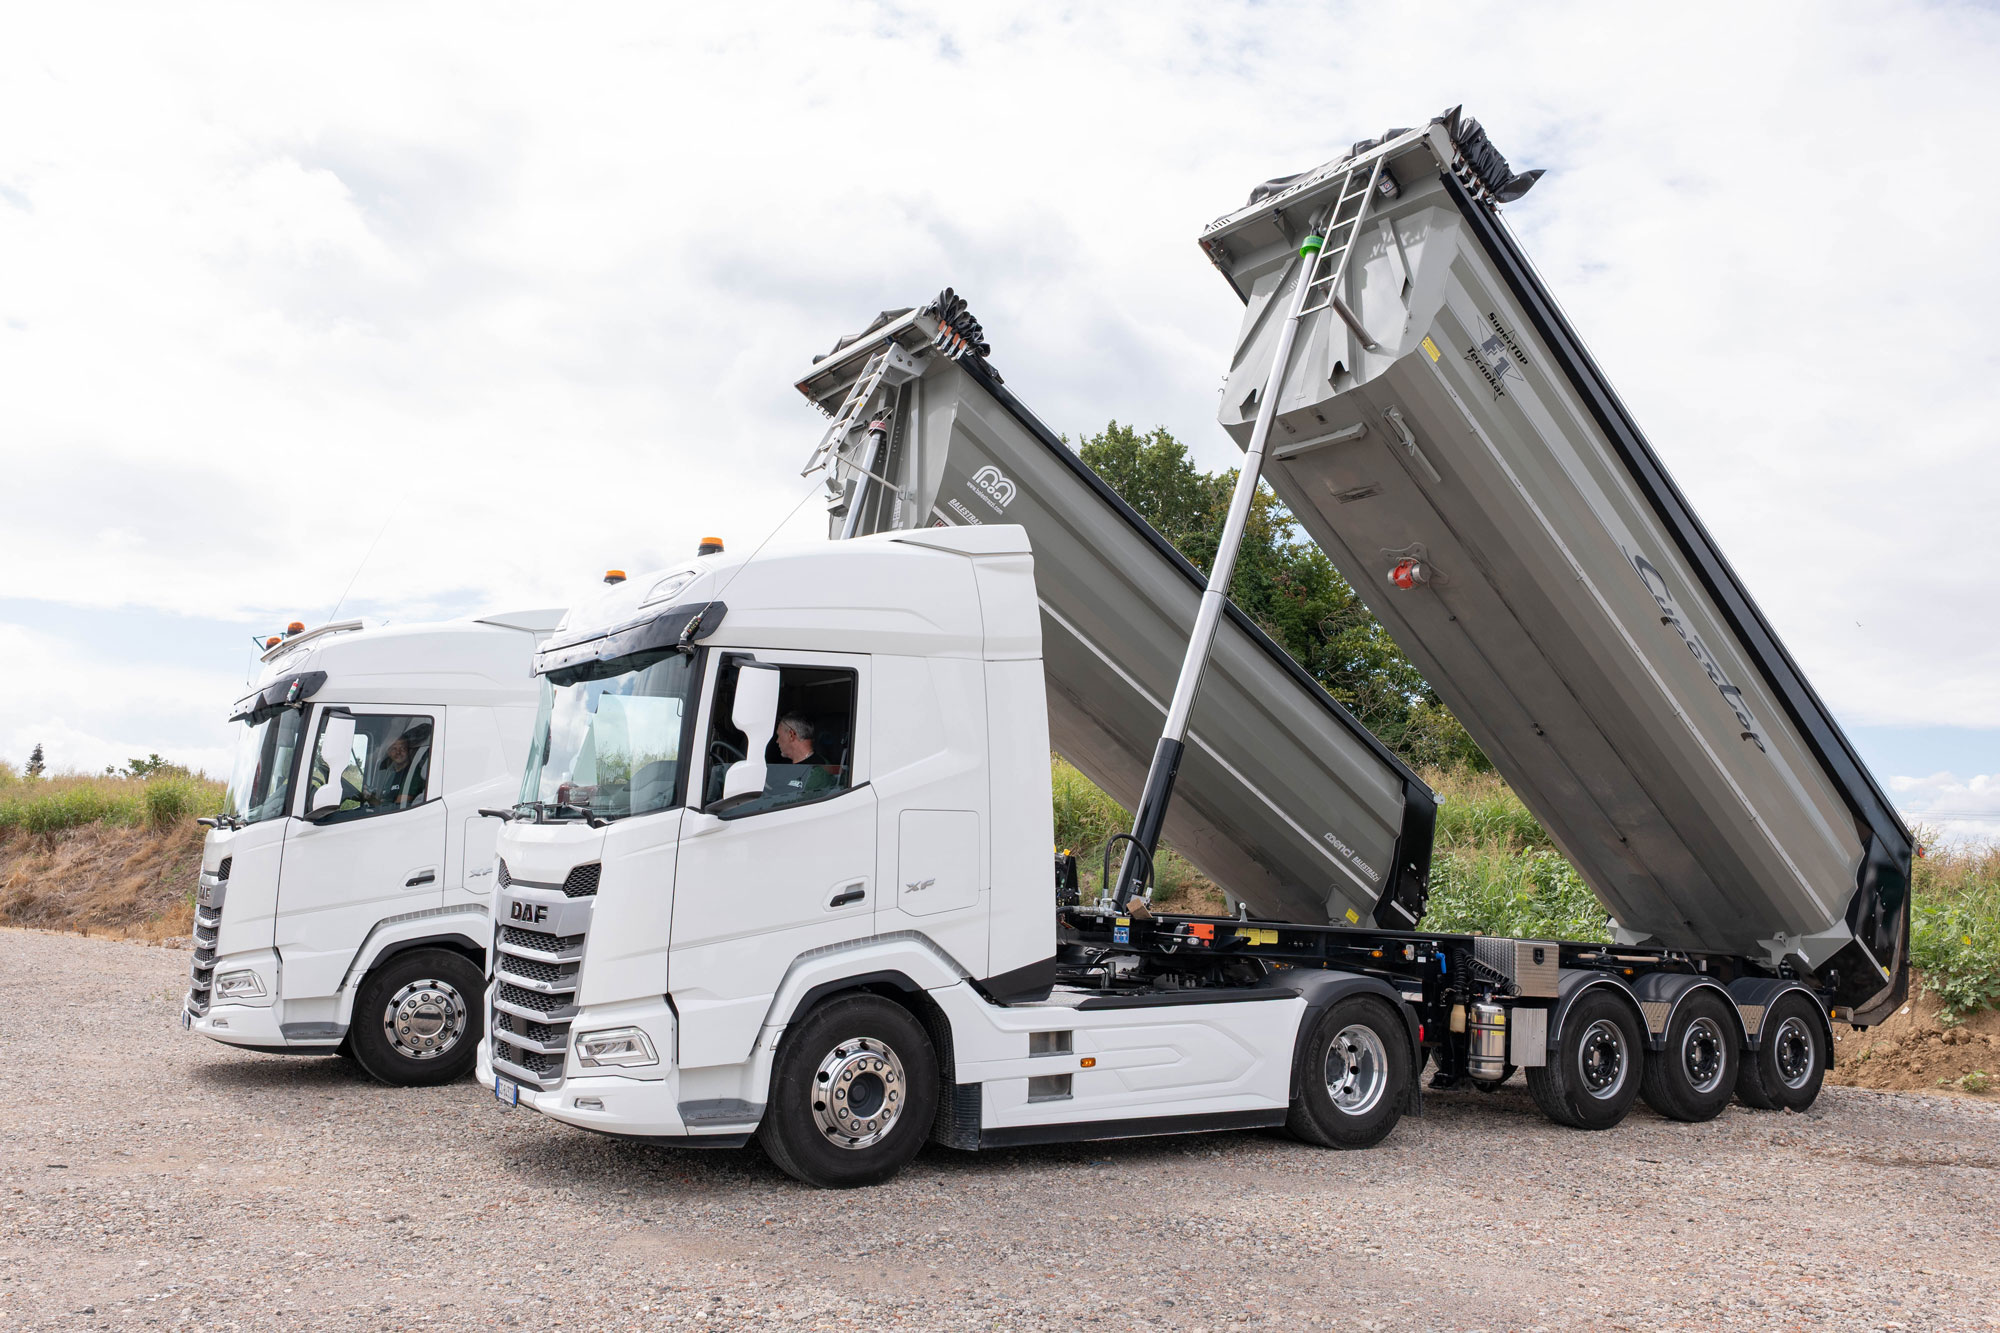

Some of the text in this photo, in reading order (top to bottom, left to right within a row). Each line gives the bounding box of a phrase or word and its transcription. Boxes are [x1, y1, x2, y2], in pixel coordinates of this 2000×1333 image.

[1488, 312, 1528, 365] SuperTOP
[1466, 346, 1505, 397] Tecnokar
[904, 878, 936, 893] XF
[511, 901, 548, 923] DAF
